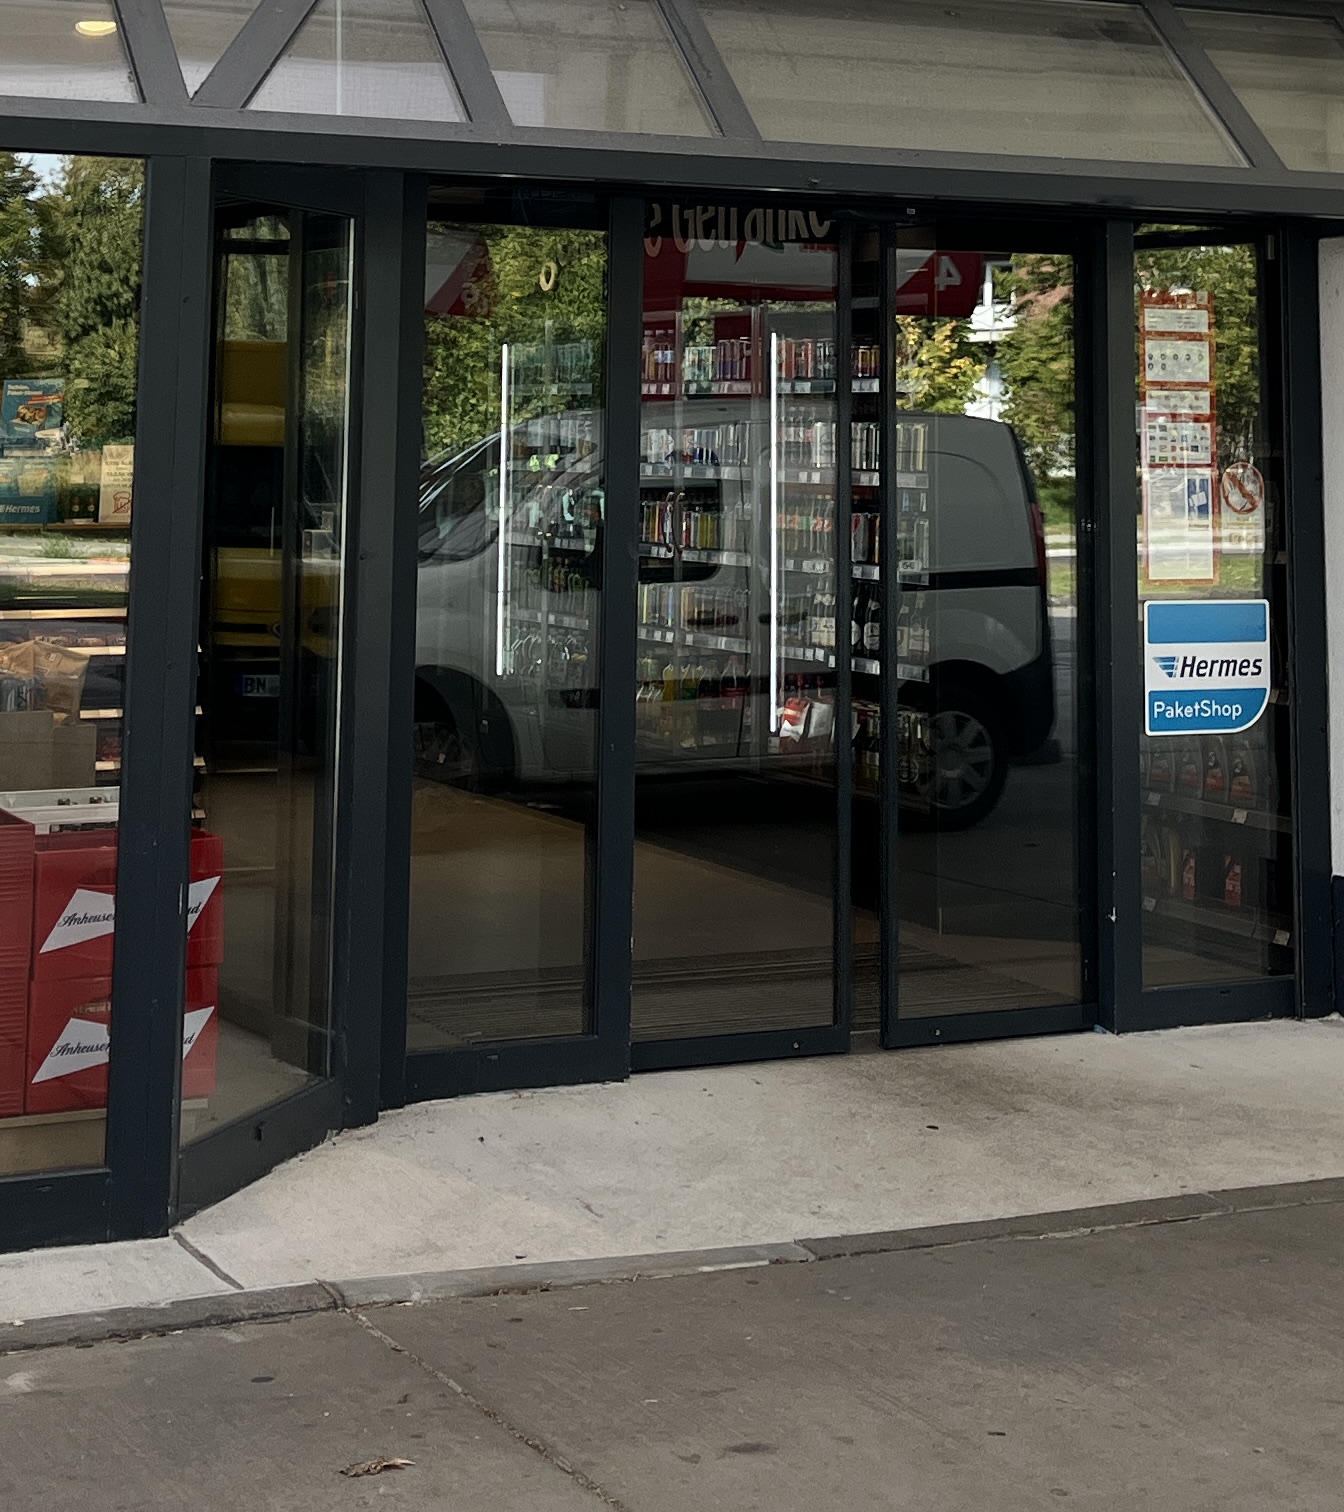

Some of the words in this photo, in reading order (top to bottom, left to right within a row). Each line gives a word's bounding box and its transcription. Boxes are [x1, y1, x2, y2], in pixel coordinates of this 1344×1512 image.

[1179, 656, 1263, 678] Hermes
[1153, 699, 1242, 721] PaketShop
[56, 912, 115, 928] Anheuse
